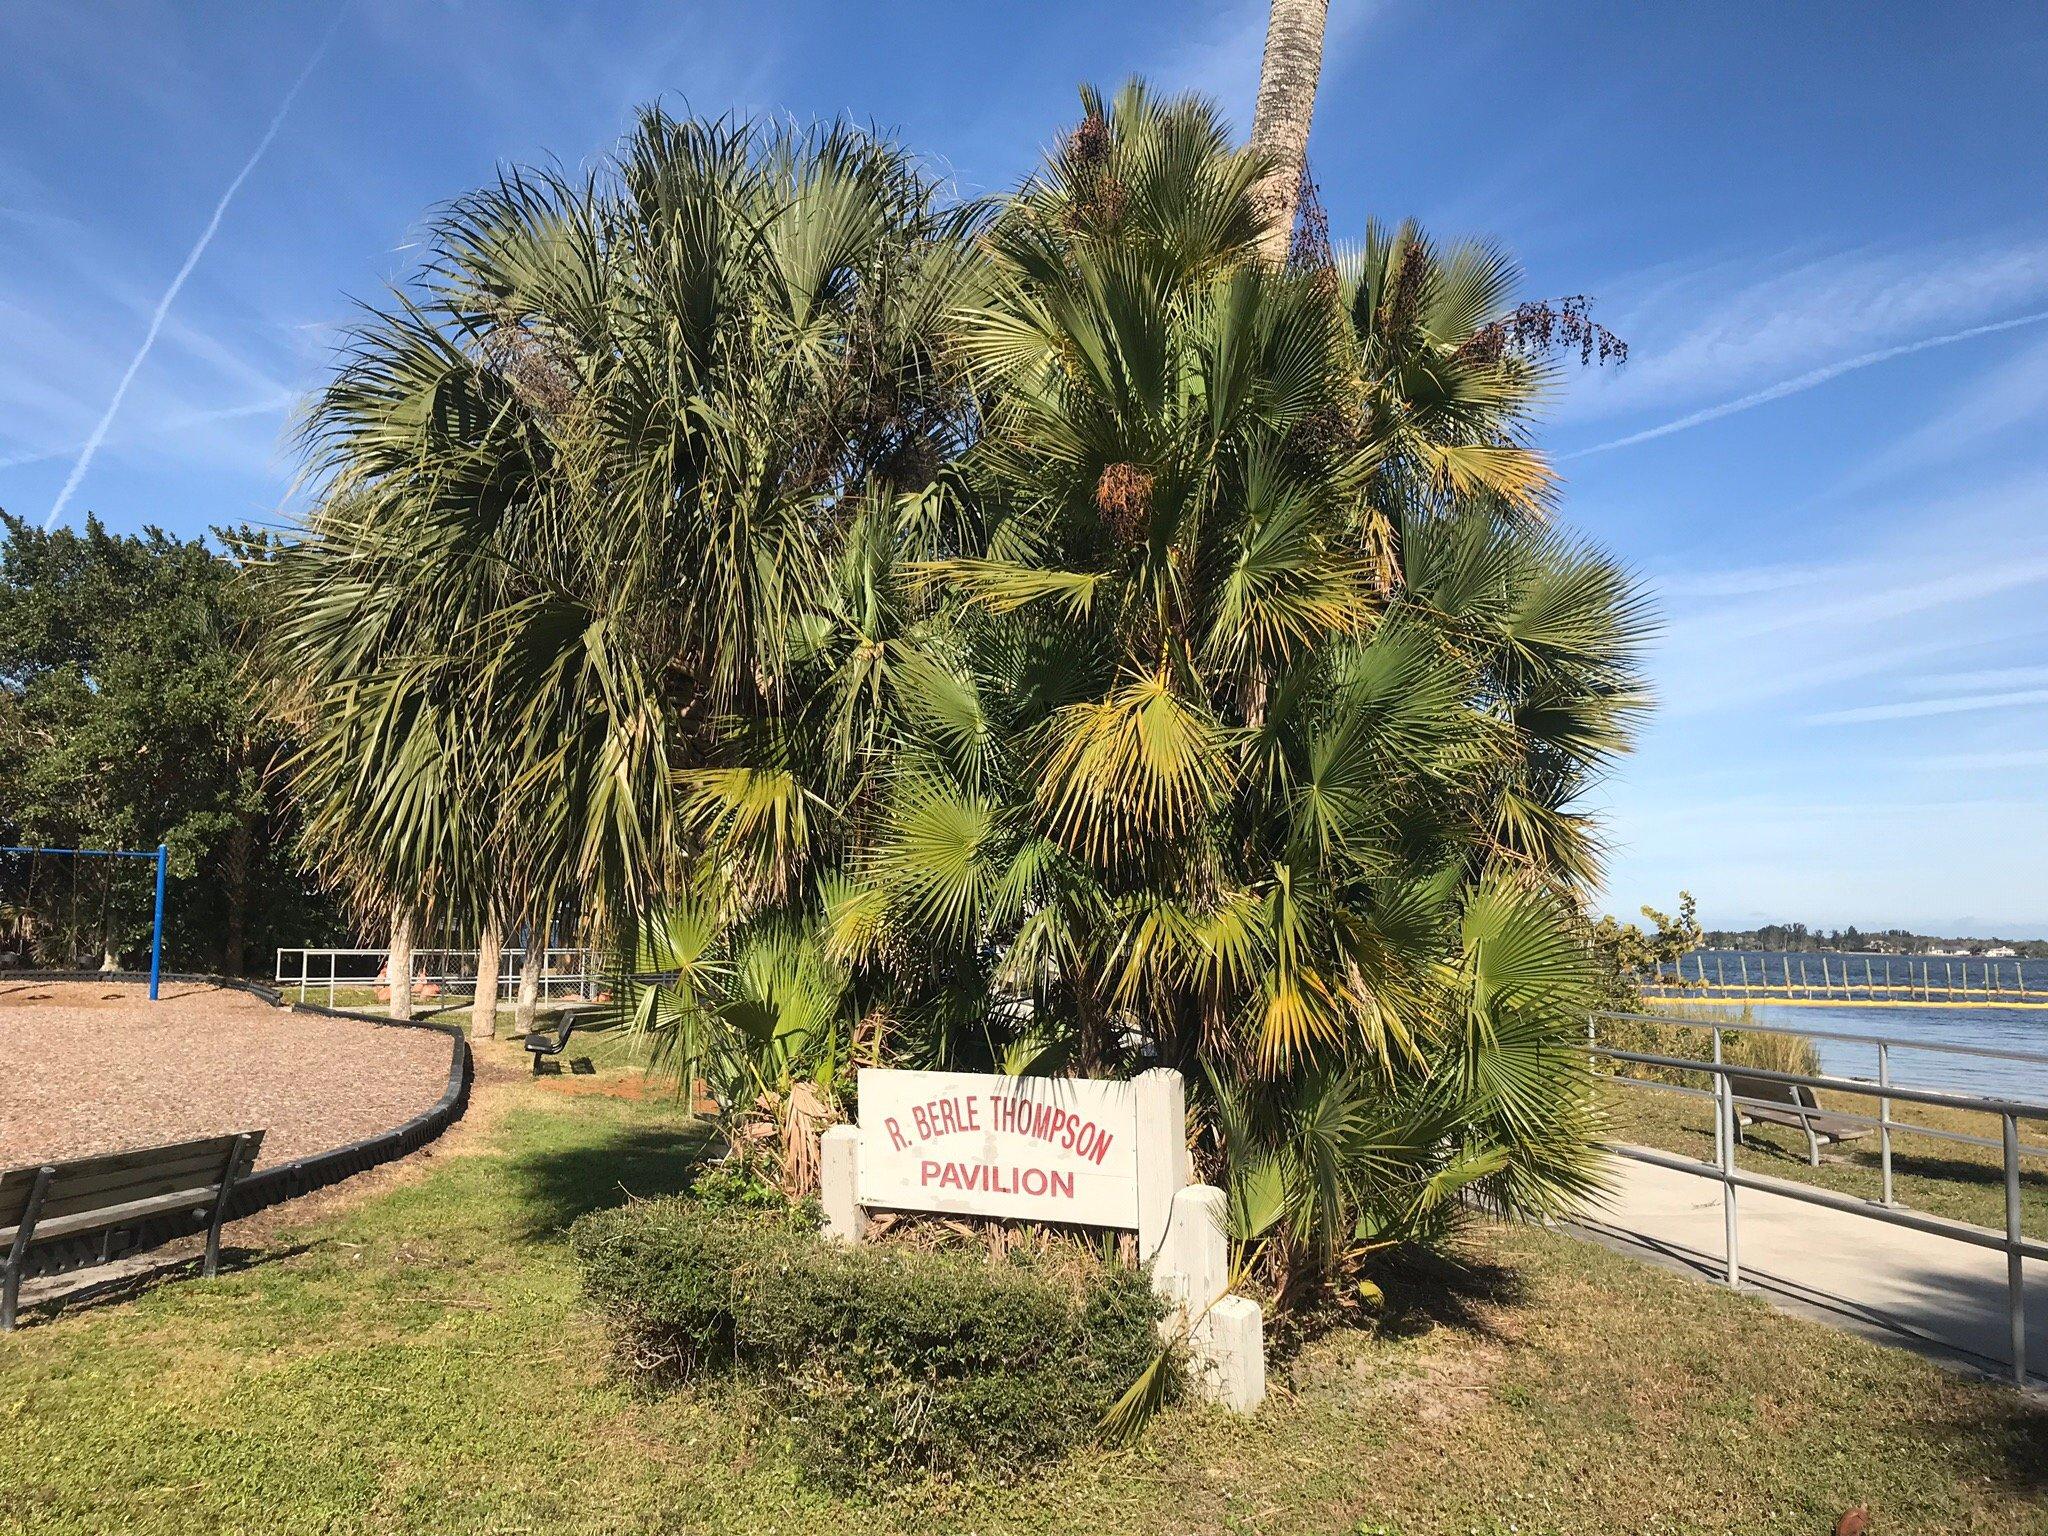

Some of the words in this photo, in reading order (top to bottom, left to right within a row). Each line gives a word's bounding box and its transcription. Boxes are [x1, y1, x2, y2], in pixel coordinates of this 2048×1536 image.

[884, 1117, 912, 1151] R.
[912, 1096, 980, 1140] BERLE
[990, 1096, 1113, 1165] THOMPSON
[921, 1160, 1074, 1198] PAVILION
